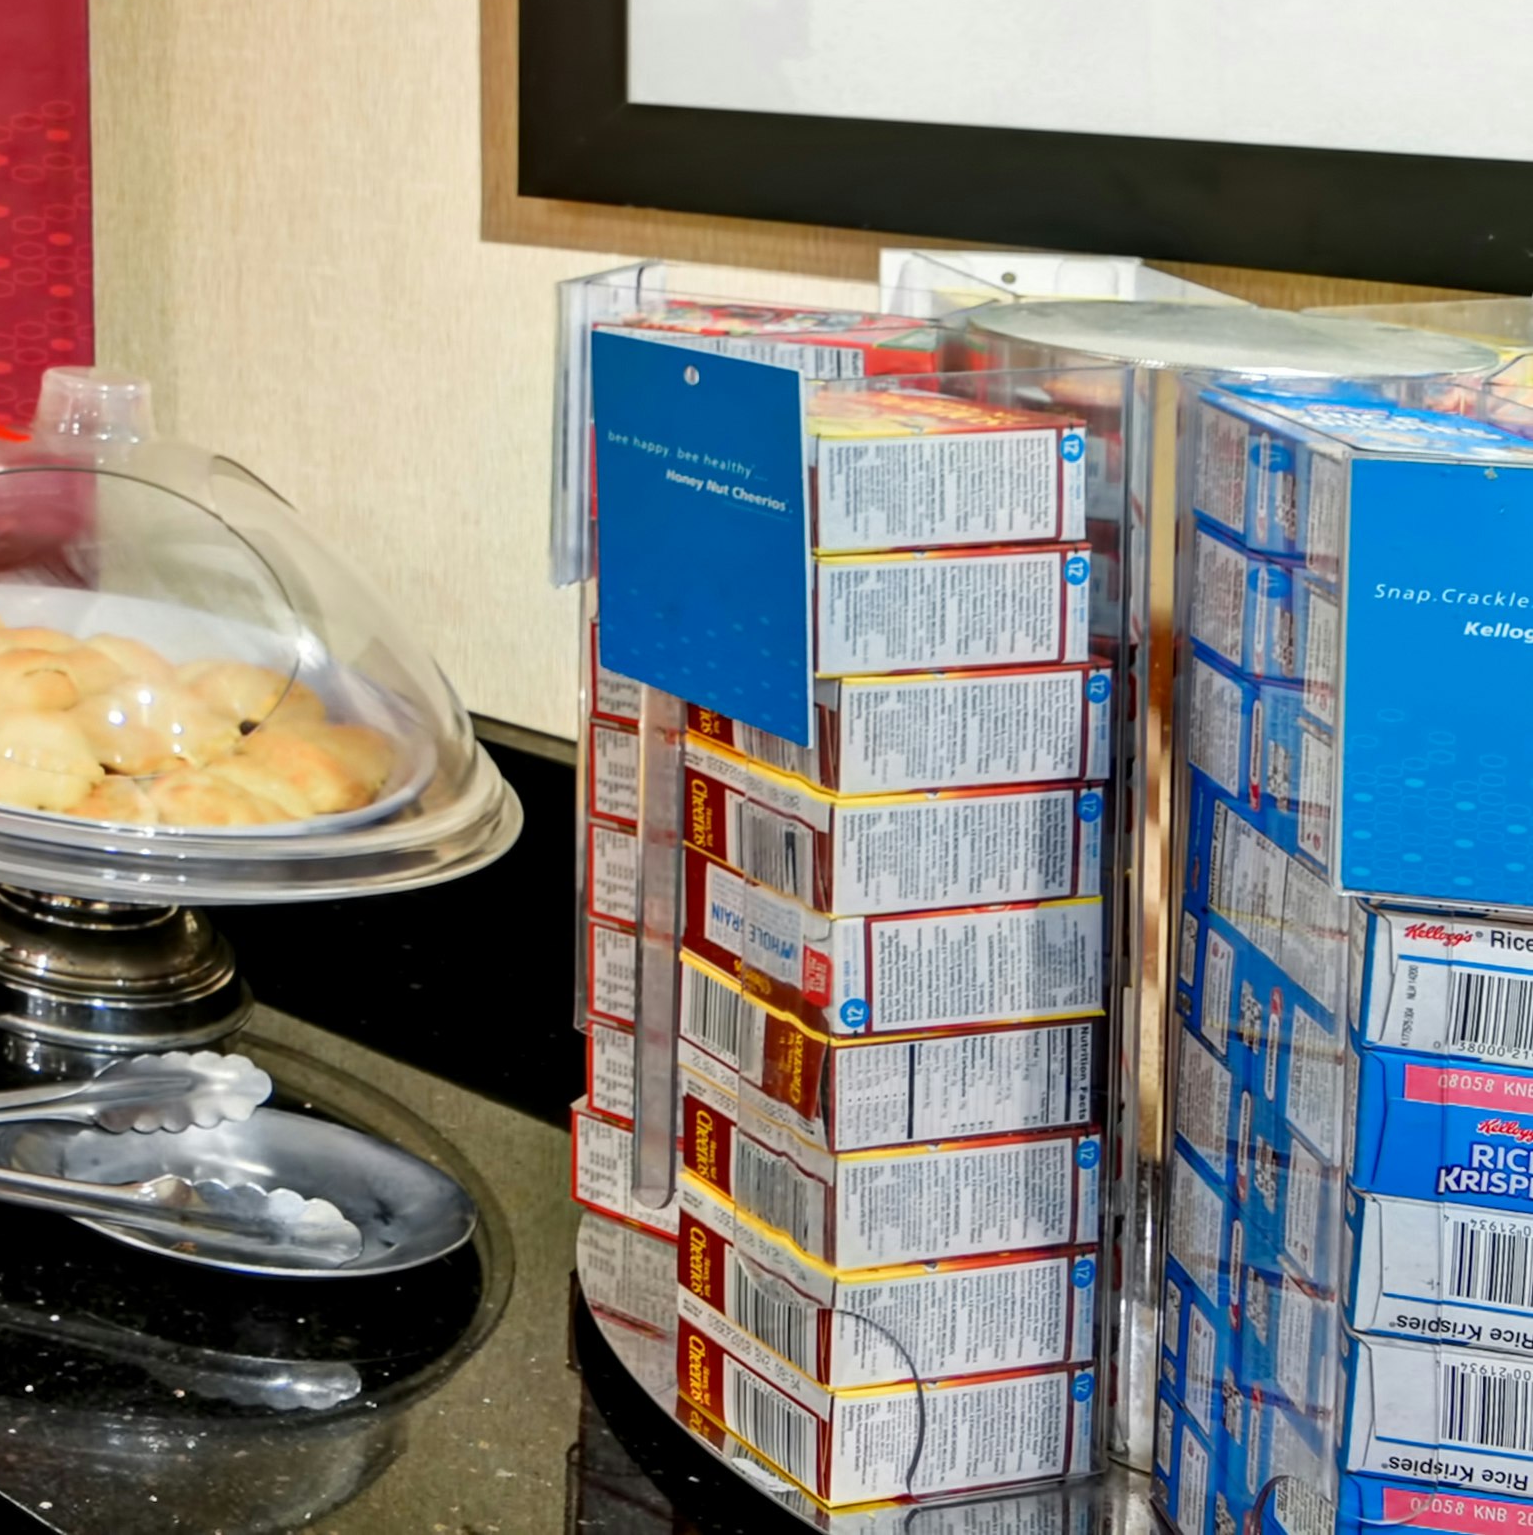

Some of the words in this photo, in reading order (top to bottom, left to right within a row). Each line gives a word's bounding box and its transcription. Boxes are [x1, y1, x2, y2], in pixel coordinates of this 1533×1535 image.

[608, 430, 629, 445] bee
[677, 447, 699, 463] bee
[666, 468, 704, 492] Honey
[706, 478, 730, 496] Nut
[846, 1007, 864, 1023] 12
[1079, 1026, 1090, 1082] Nutrition
[1458, 1041, 1506, 1058] 38000
[1078, 1086, 1089, 1121] Facts
[1080, 1145, 1094, 1160] 12
[1076, 1264, 1090, 1280] 12
[1076, 1379, 1090, 1395] 12
[1482, 1469, 1528, 1492] Rice
[1474, 1504, 1508, 1523] KNB
